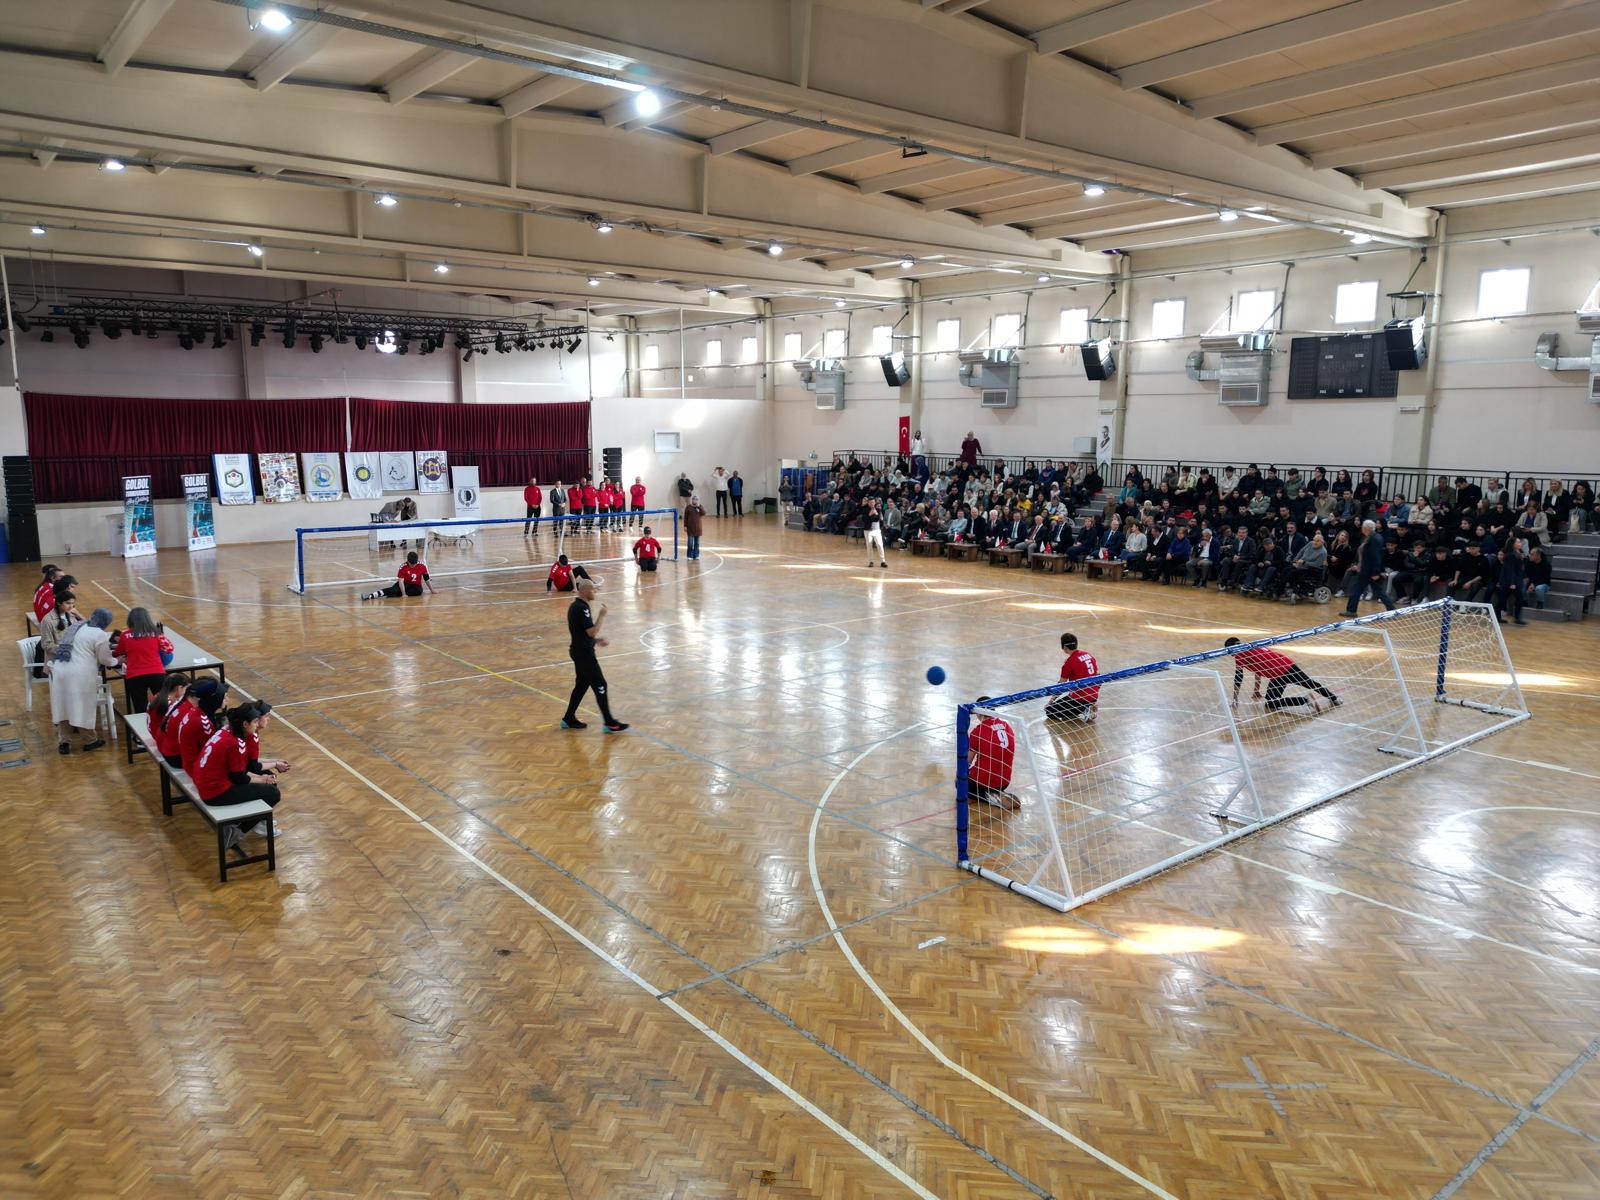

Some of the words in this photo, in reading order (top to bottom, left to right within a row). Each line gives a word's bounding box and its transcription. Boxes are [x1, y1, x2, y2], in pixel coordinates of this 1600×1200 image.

[125, 478, 149, 490] GOLBOL
[184, 475, 207, 487] GOLBOL
[411, 573, 417, 582] 2
[1085, 660, 1095, 675] 5
[996, 730, 1009, 748] 9
